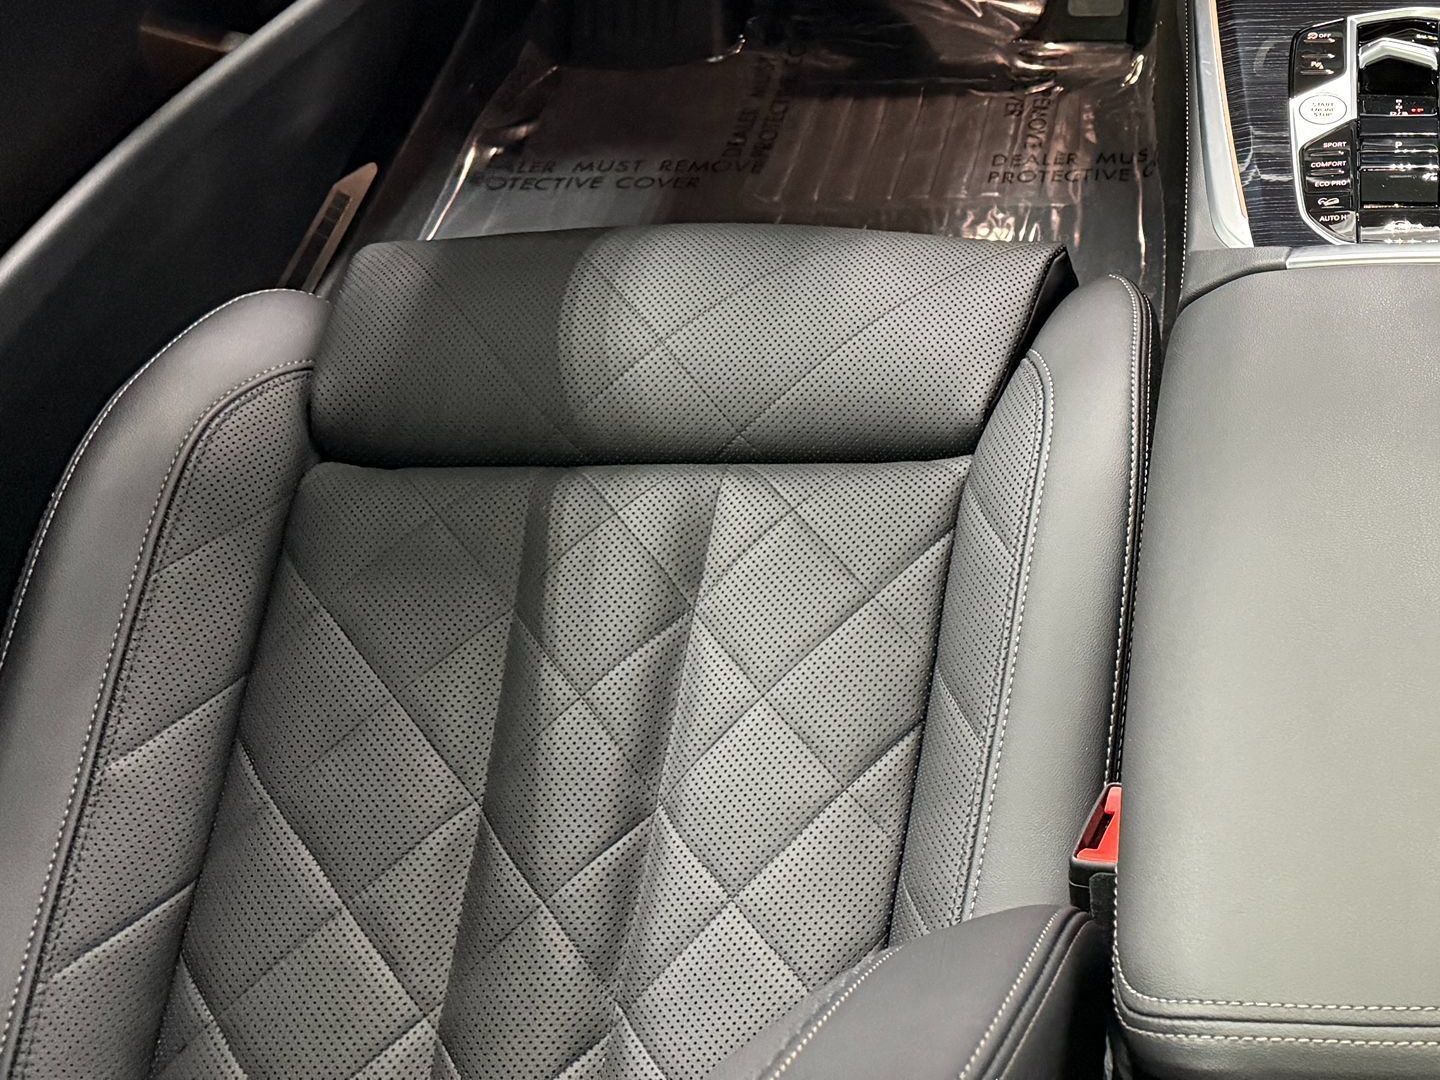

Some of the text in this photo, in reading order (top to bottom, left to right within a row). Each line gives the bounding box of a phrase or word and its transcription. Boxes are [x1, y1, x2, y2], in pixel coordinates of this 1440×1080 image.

[575, 159, 649, 172] MUST
[660, 159, 762, 172] REMOVE
[991, 148, 1152, 168] DEALER MUS
[470, 175, 699, 191] OTECTIVE COVER
[988, 169, 1129, 184] PROTECTIVE
